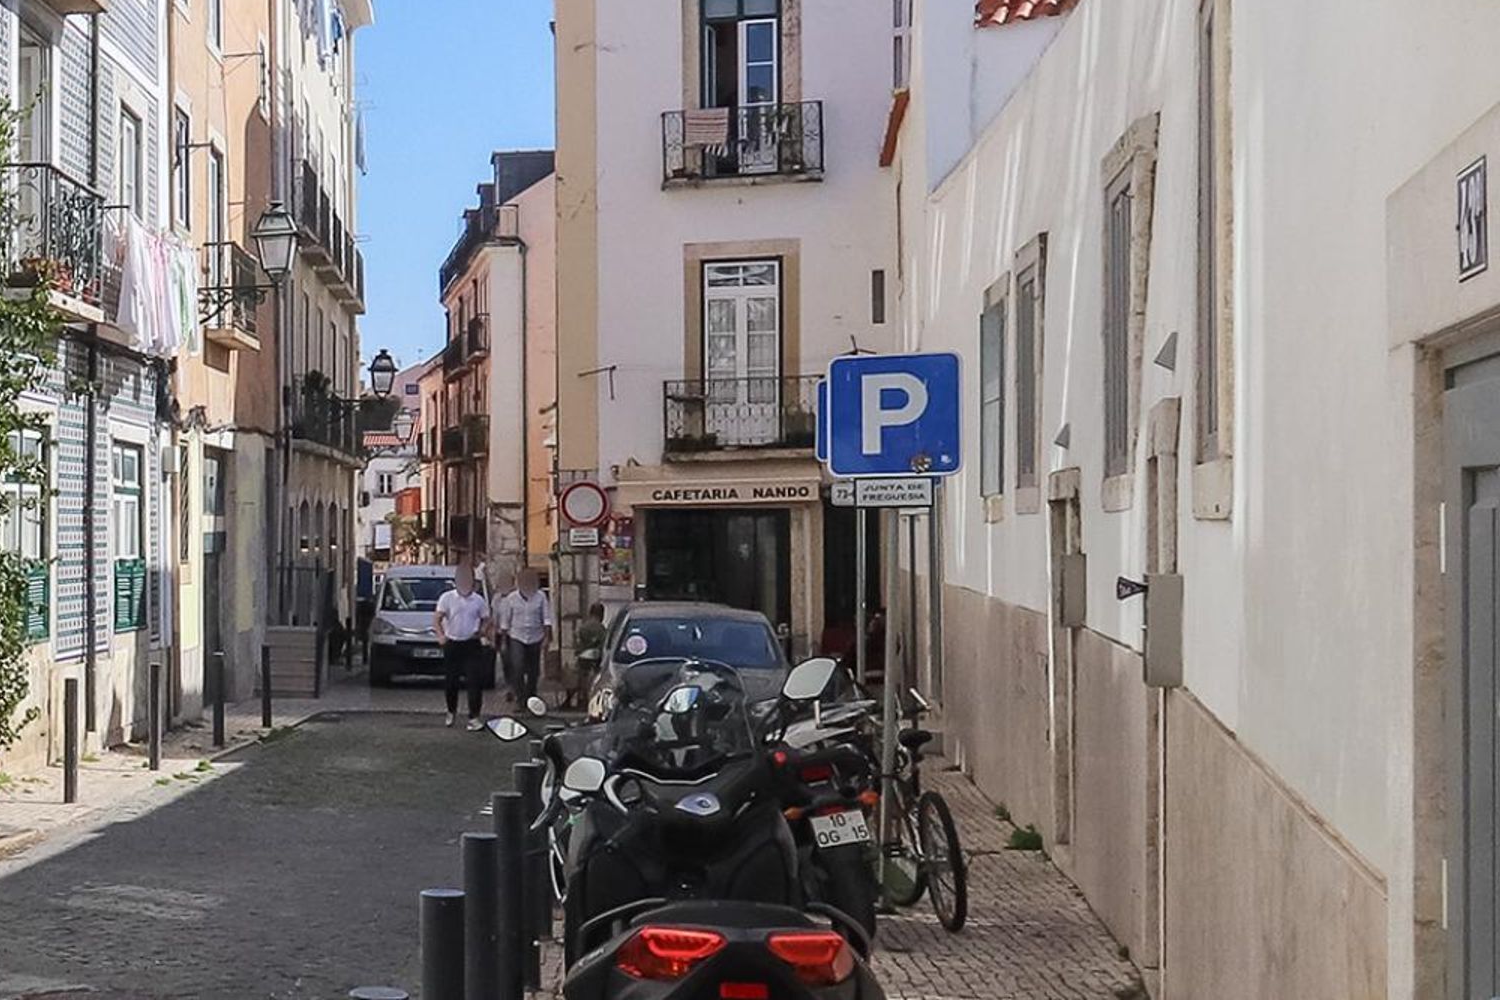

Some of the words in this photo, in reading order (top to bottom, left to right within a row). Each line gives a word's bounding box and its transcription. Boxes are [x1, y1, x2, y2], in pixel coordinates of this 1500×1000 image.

[861, 372, 928, 455] P
[652, 488, 739, 501] CAFETARIA
[752, 486, 810, 498] NANDO
[862, 492, 926, 500] FREGUESIA
[829, 813, 846, 827] 10
